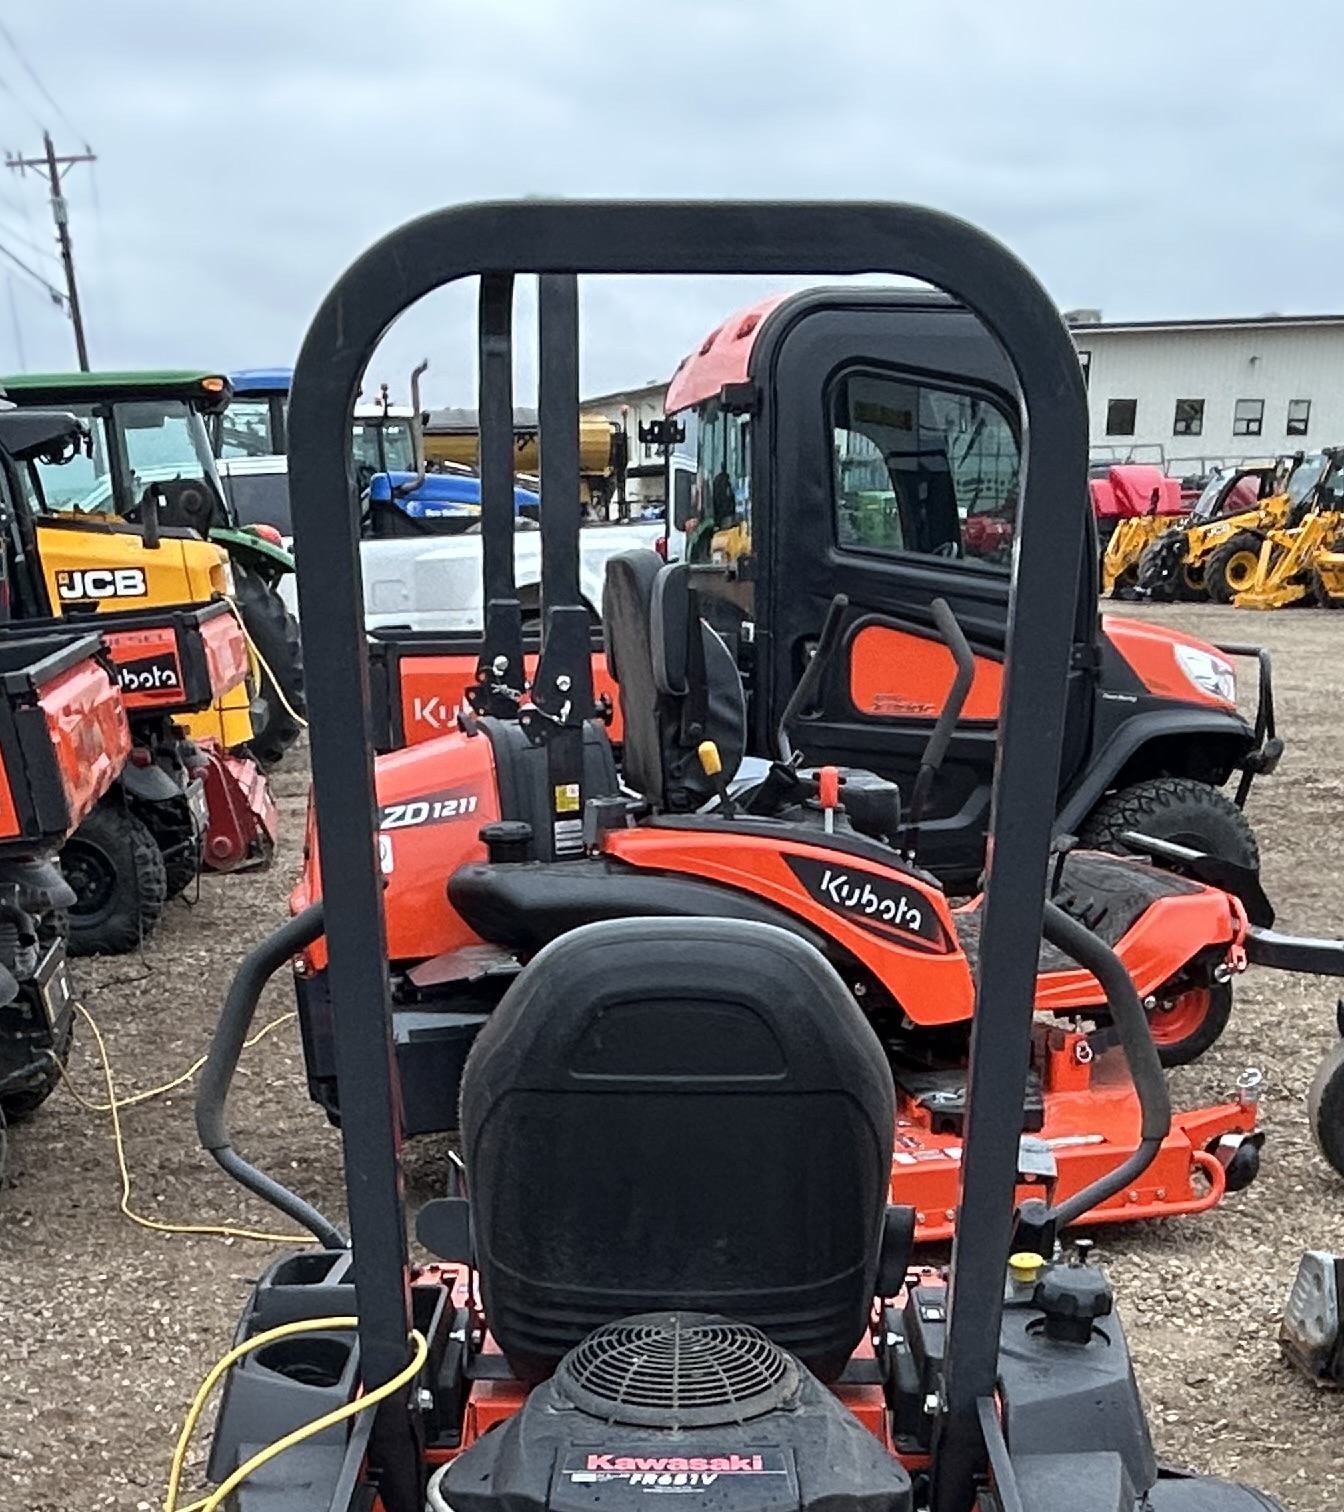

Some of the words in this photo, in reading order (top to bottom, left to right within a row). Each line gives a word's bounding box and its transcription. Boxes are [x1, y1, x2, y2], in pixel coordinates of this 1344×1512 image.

[59, 569, 146, 598] JCB
[380, 801, 430, 830] ZD
[432, 796, 478, 818] 1211
[820, 870, 922, 931] Kubota
[587, 1454, 763, 1471] Kawasaki
